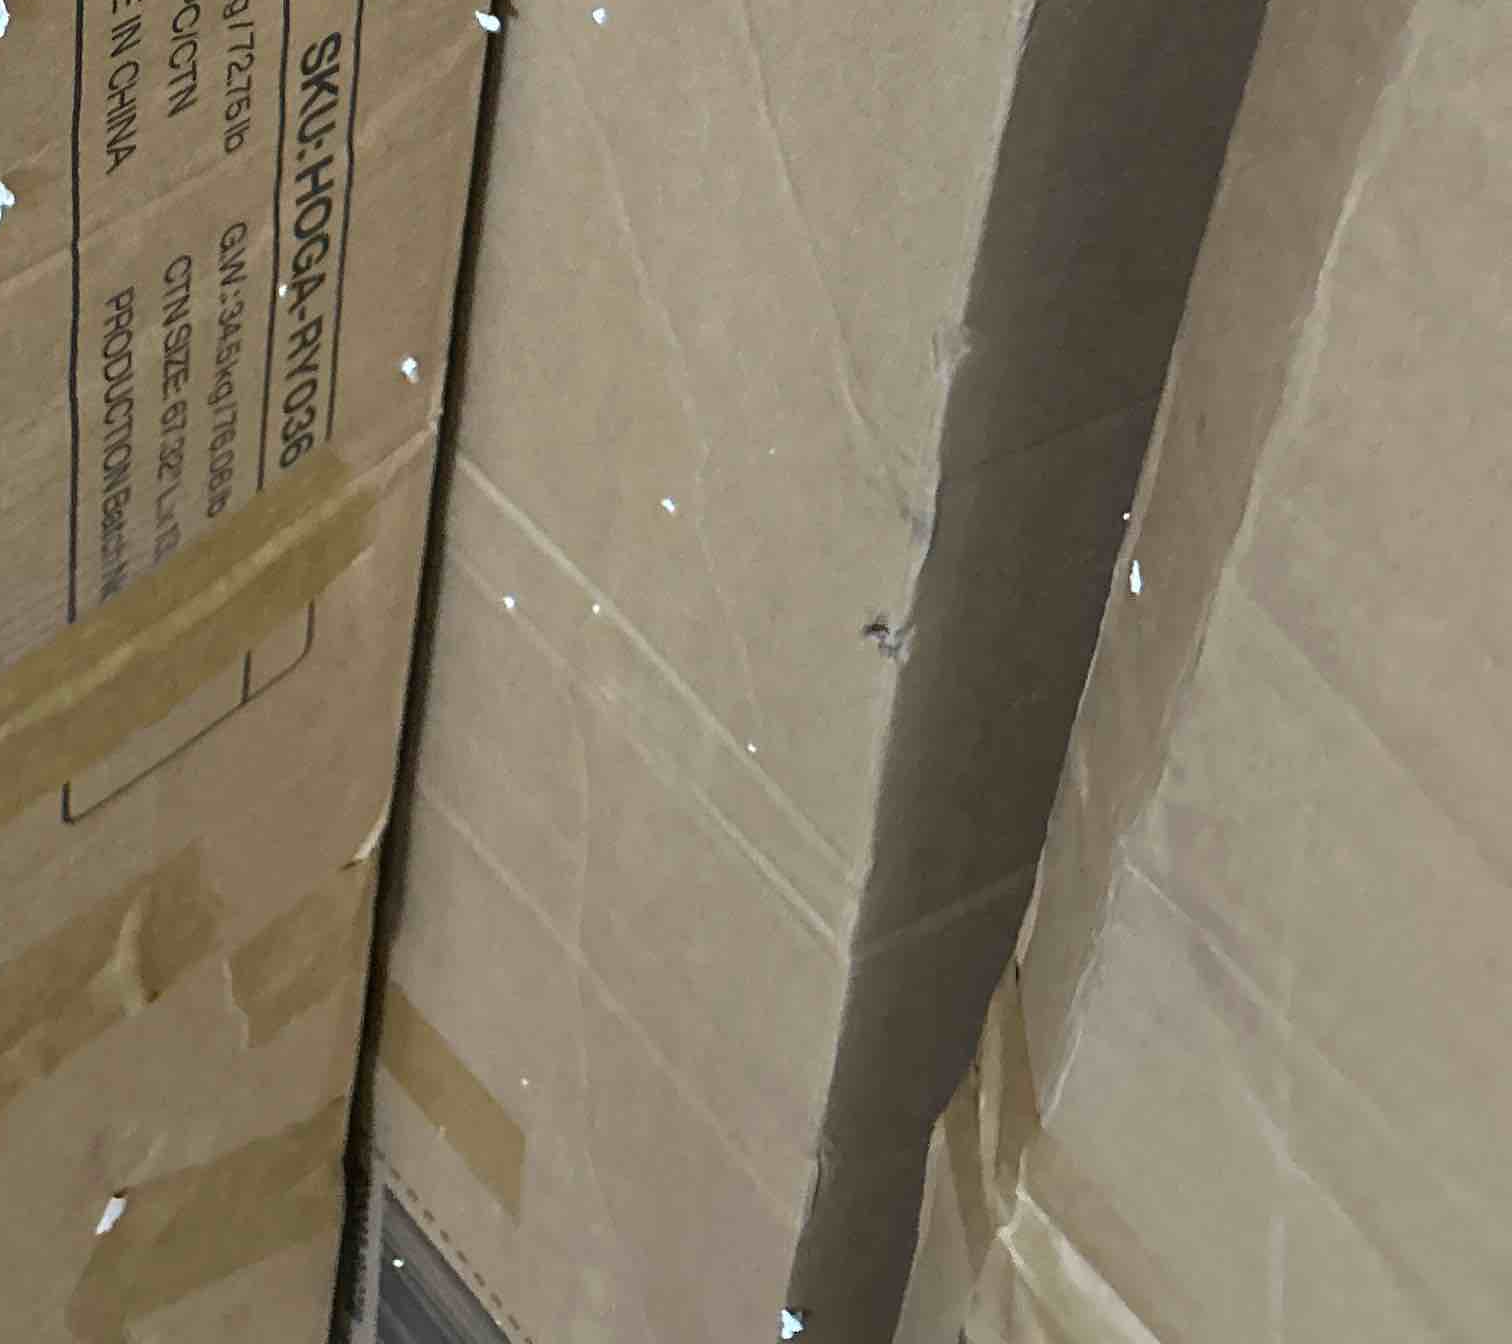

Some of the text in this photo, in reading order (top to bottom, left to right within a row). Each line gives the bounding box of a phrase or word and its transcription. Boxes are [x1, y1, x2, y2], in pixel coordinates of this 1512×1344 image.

[110, 14, 142, 58] IN
[106, 61, 139, 175] CHINA
[102, 285, 135, 494] PRODUCTION
